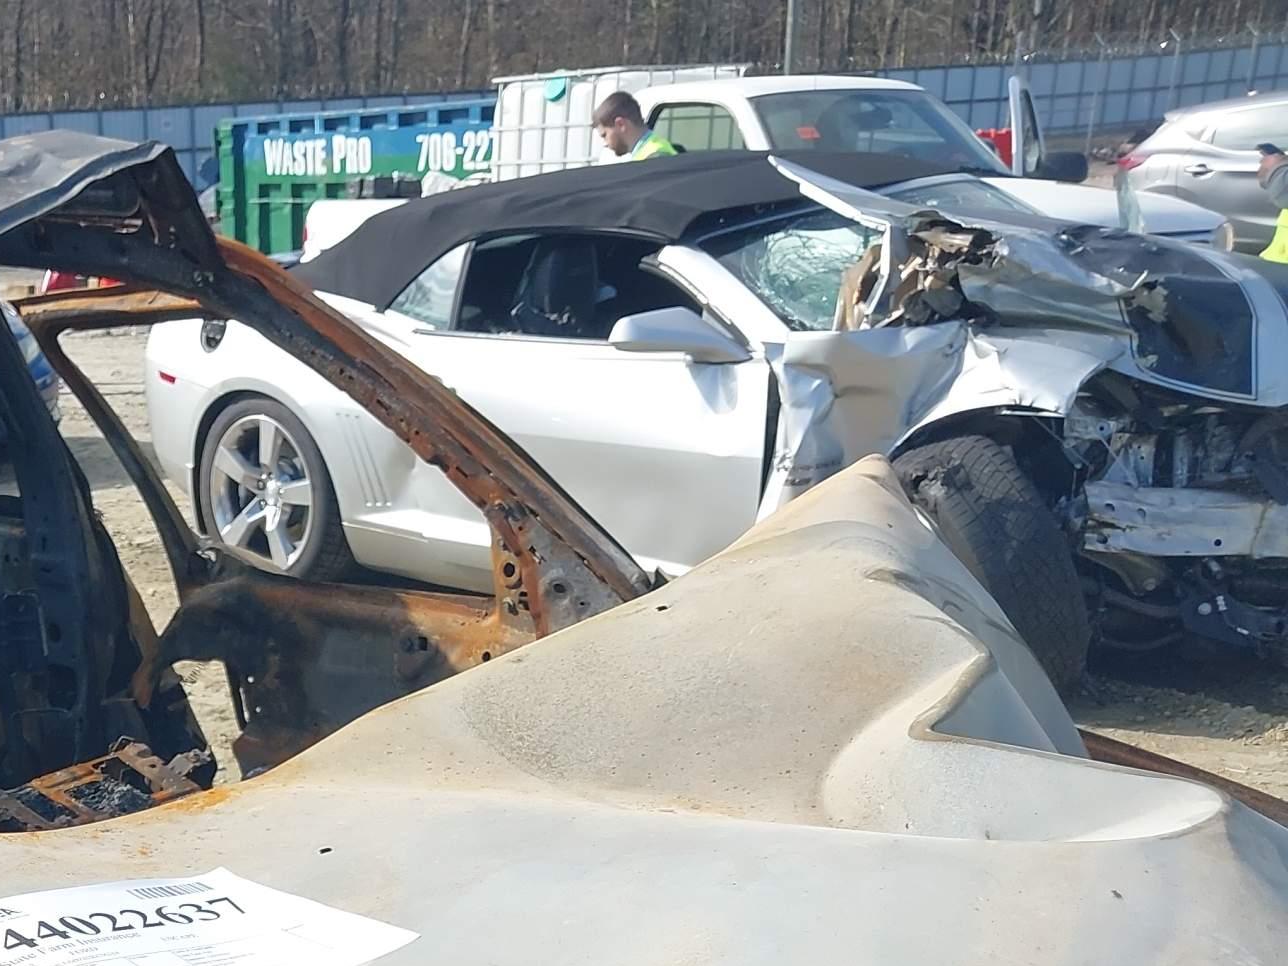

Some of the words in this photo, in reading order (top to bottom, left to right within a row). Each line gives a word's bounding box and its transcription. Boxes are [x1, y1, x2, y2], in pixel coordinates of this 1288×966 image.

[263, 138, 327, 177] WASTE
[331, 133, 373, 175] PRO
[415, 129, 493, 173] 706-22
[2, 896, 246, 950] 44022637
[37, 941, 76, 956] Farm
[76, 931, 142, 946] Insurance
